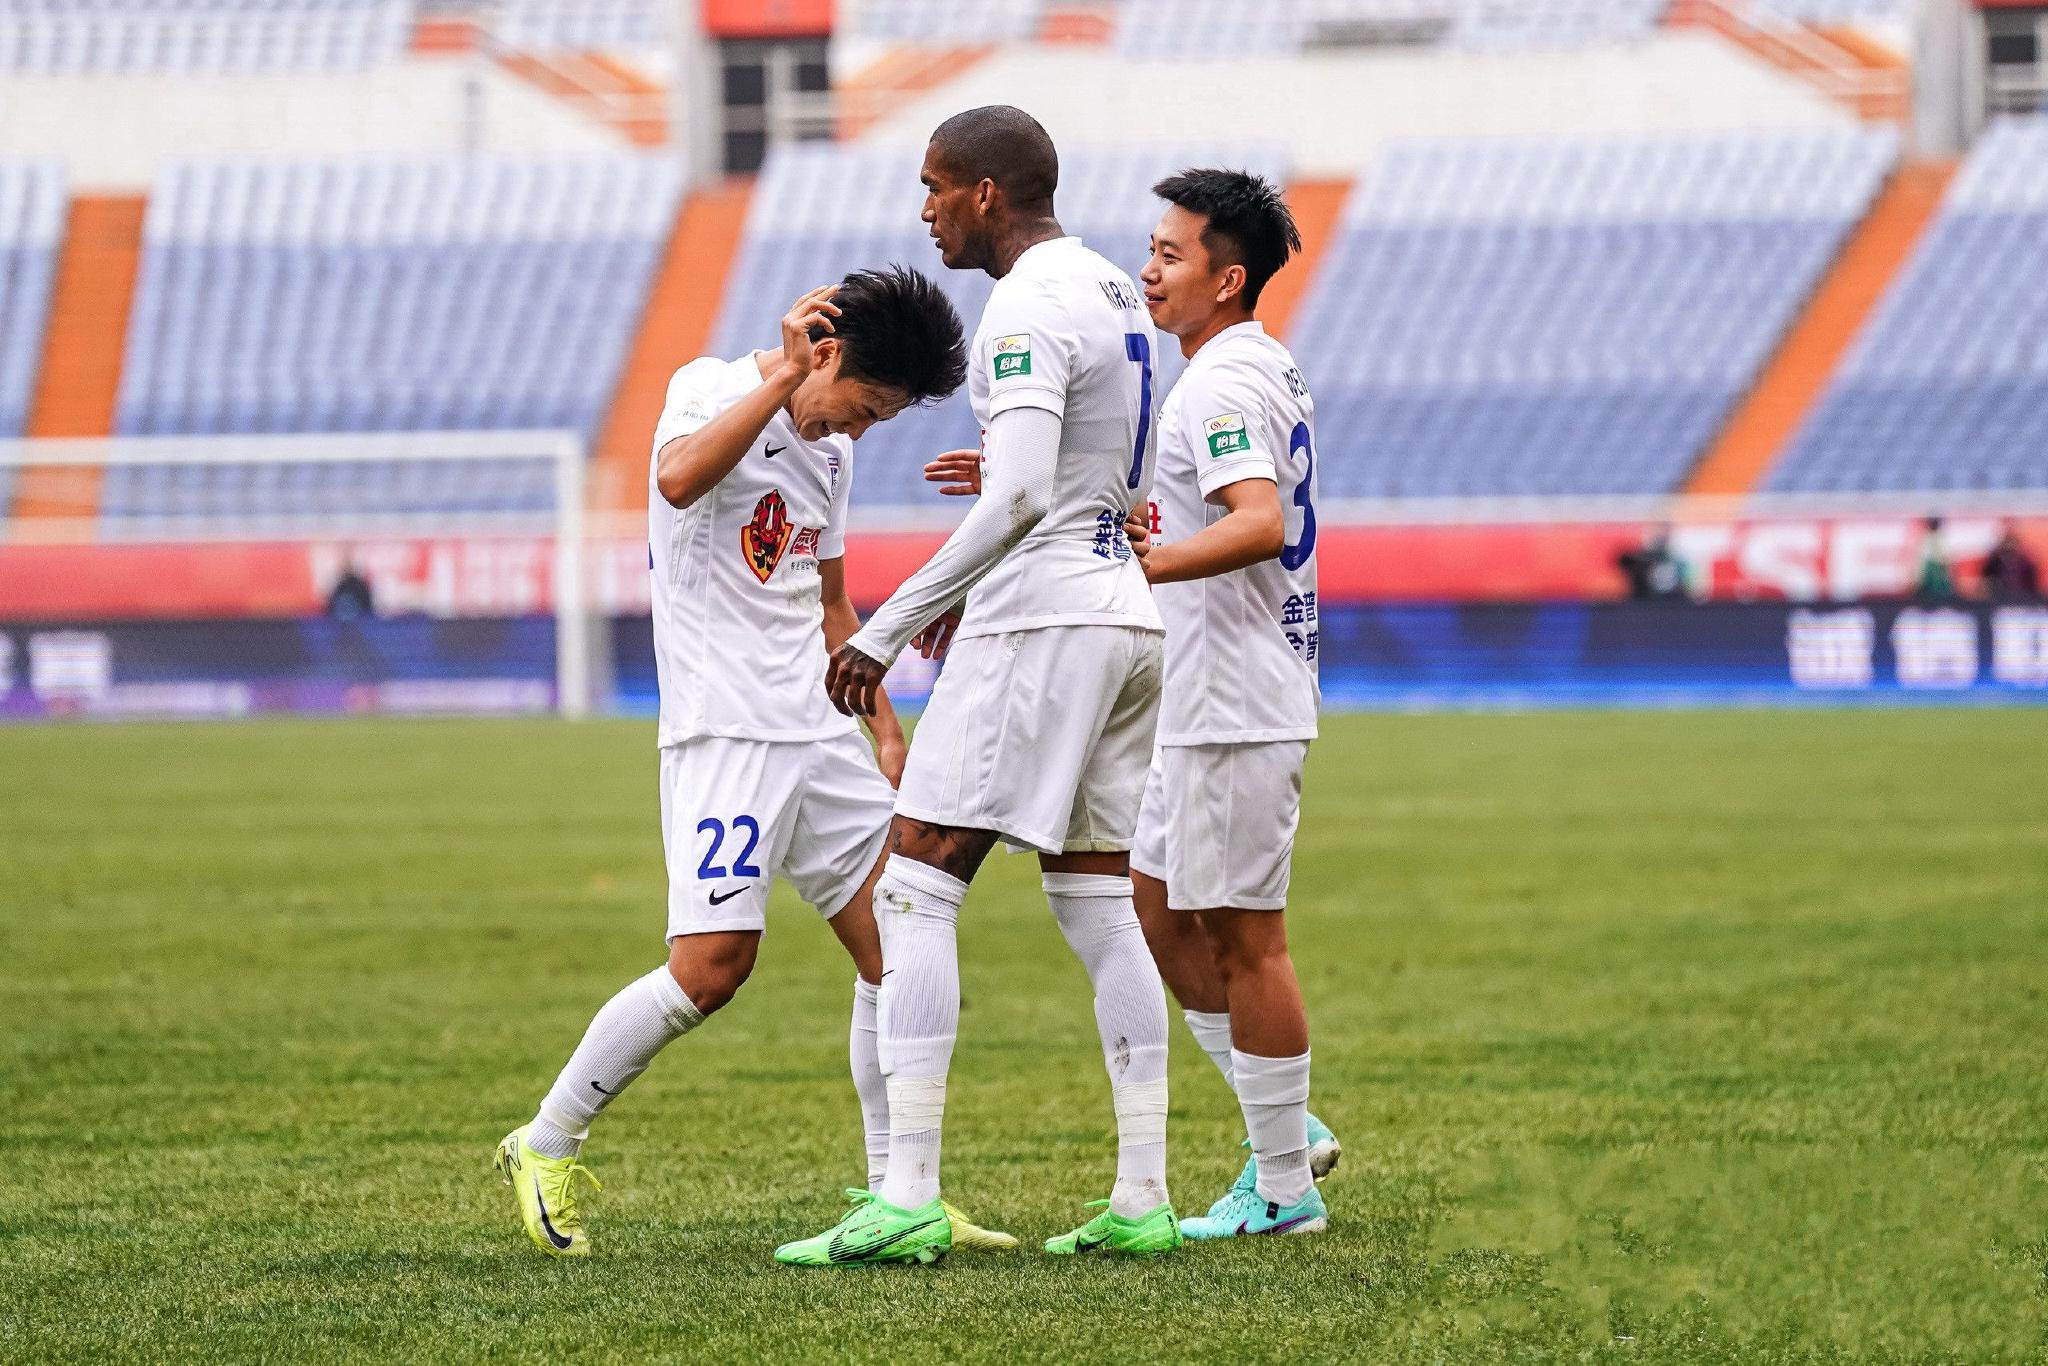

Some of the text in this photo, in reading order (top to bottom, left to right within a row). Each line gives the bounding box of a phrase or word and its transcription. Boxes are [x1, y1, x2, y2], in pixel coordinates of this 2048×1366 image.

[1124, 333, 1152, 489] 7
[1279, 421, 1316, 571] 3
[697, 815, 760, 880] 22
